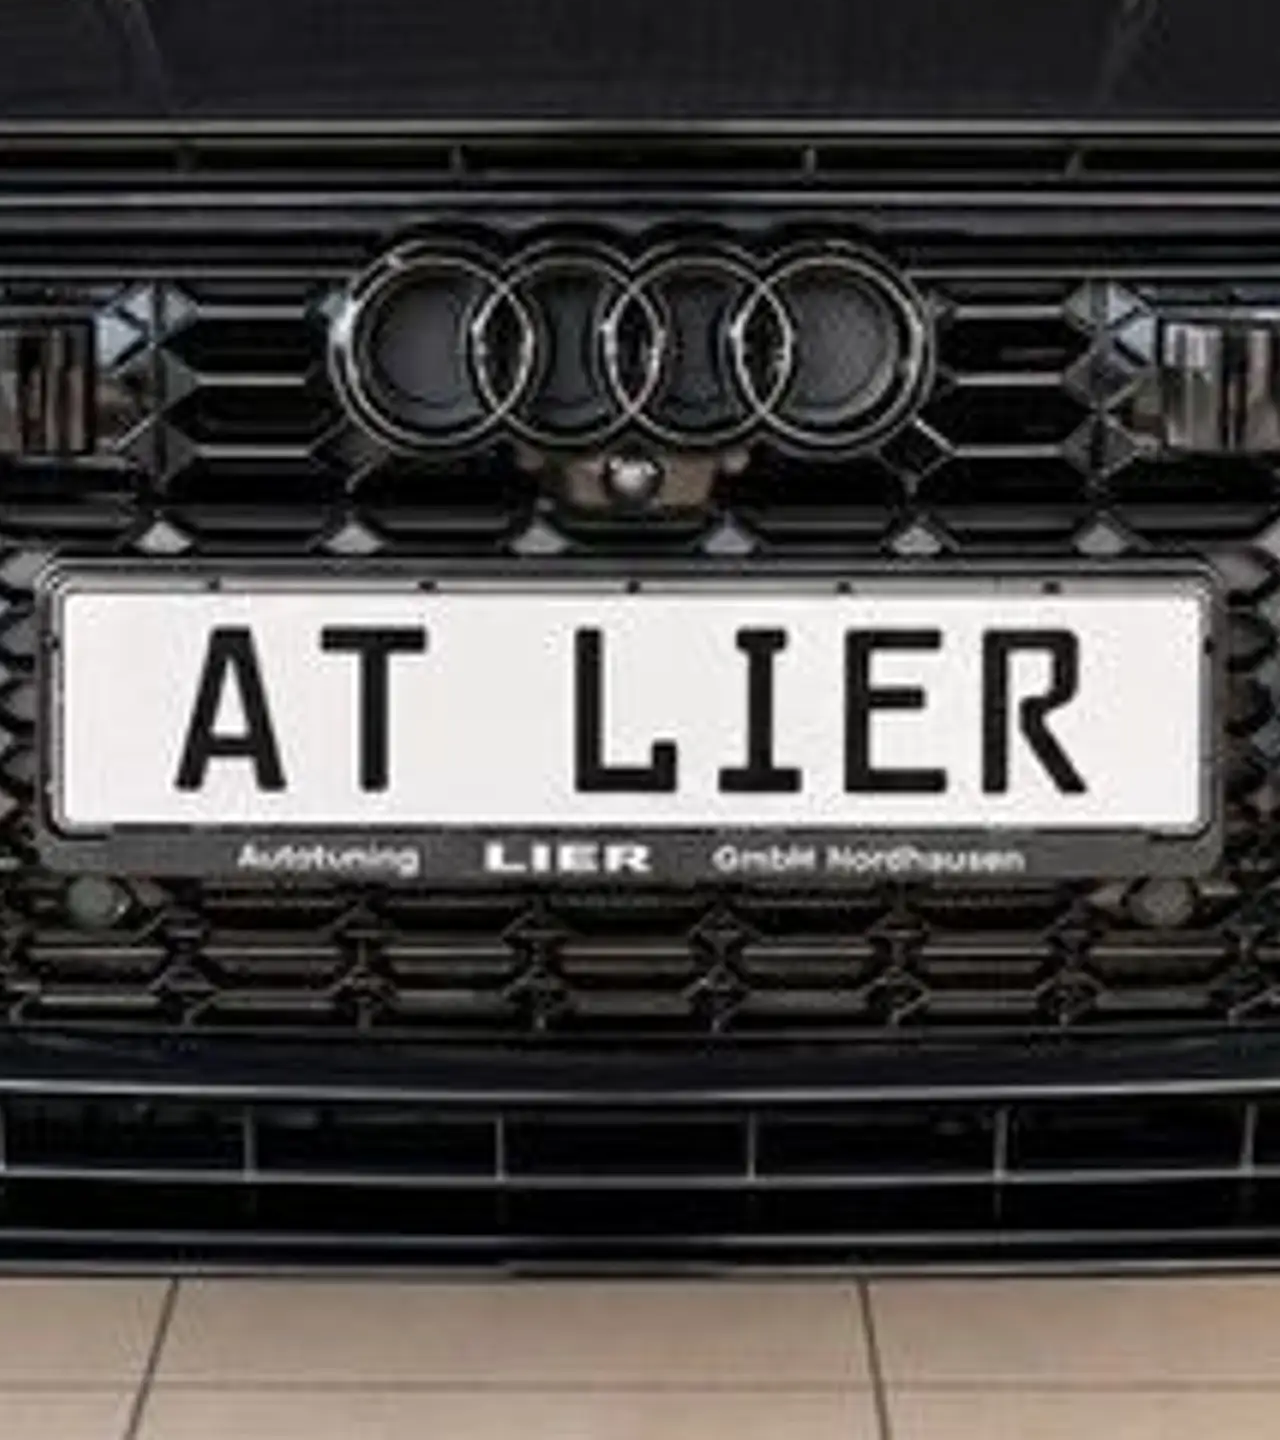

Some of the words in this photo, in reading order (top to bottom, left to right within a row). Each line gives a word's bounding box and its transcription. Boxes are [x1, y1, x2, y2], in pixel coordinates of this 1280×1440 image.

[174, 625, 427, 793] AT
[574, 626, 1087, 793] LIER
[237, 843, 420, 878] Autotuning
[483, 841, 652, 874] LIER
[712, 844, 816, 874] GmbH
[824, 844, 1027, 875] Nordhausen
